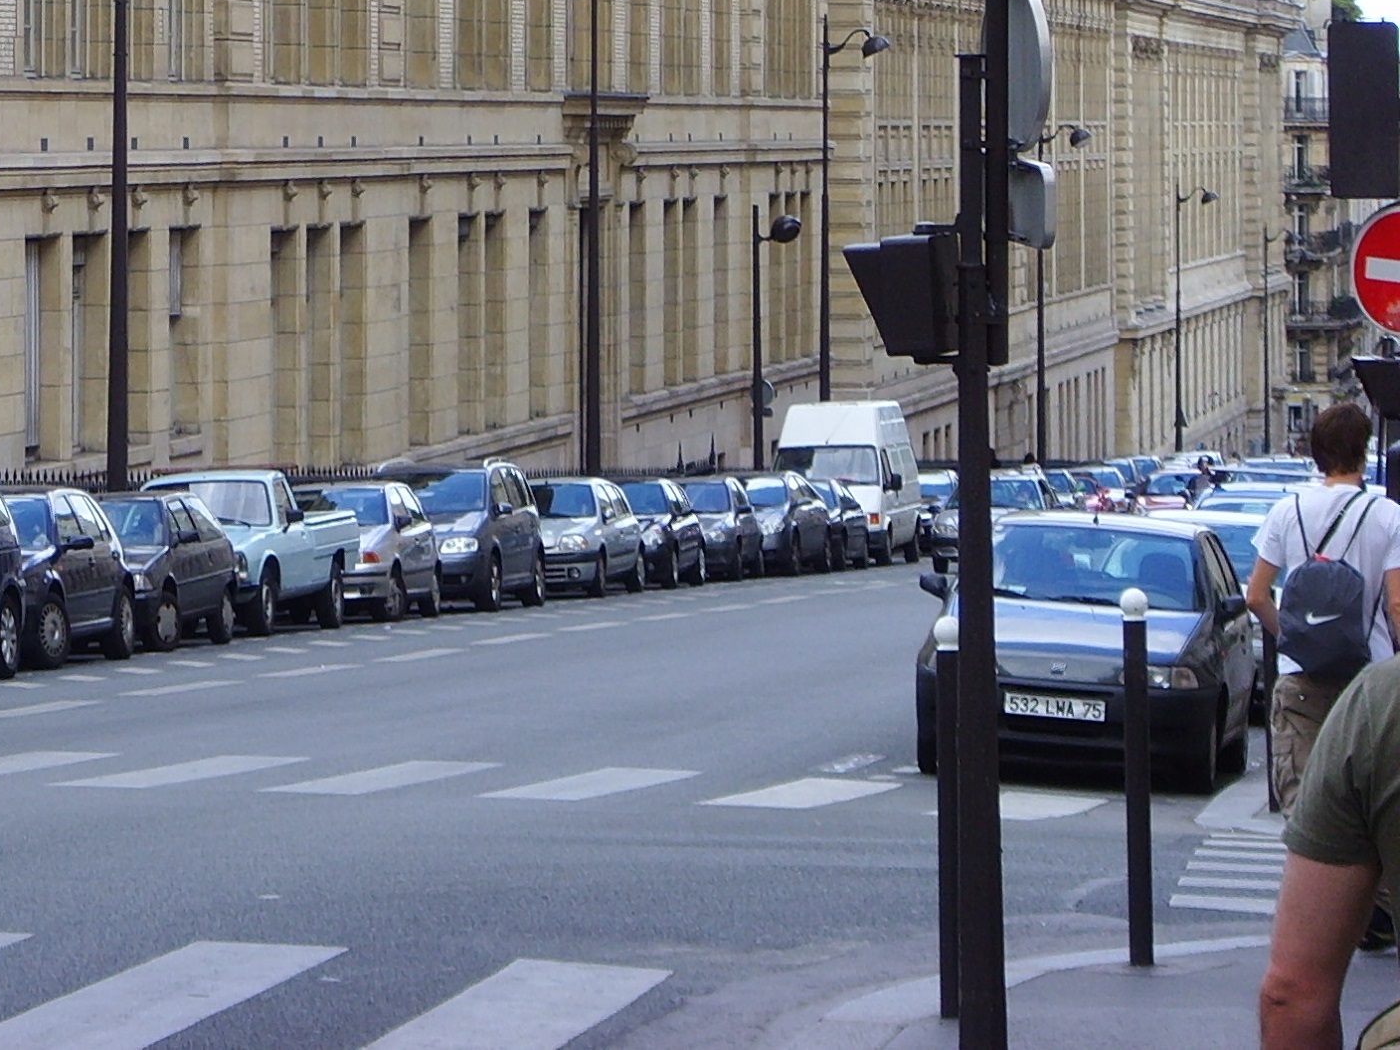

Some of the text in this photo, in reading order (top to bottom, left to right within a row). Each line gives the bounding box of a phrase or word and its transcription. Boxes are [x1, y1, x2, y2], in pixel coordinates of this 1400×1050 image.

[1009, 696, 1102, 719] 532 LWA 75
